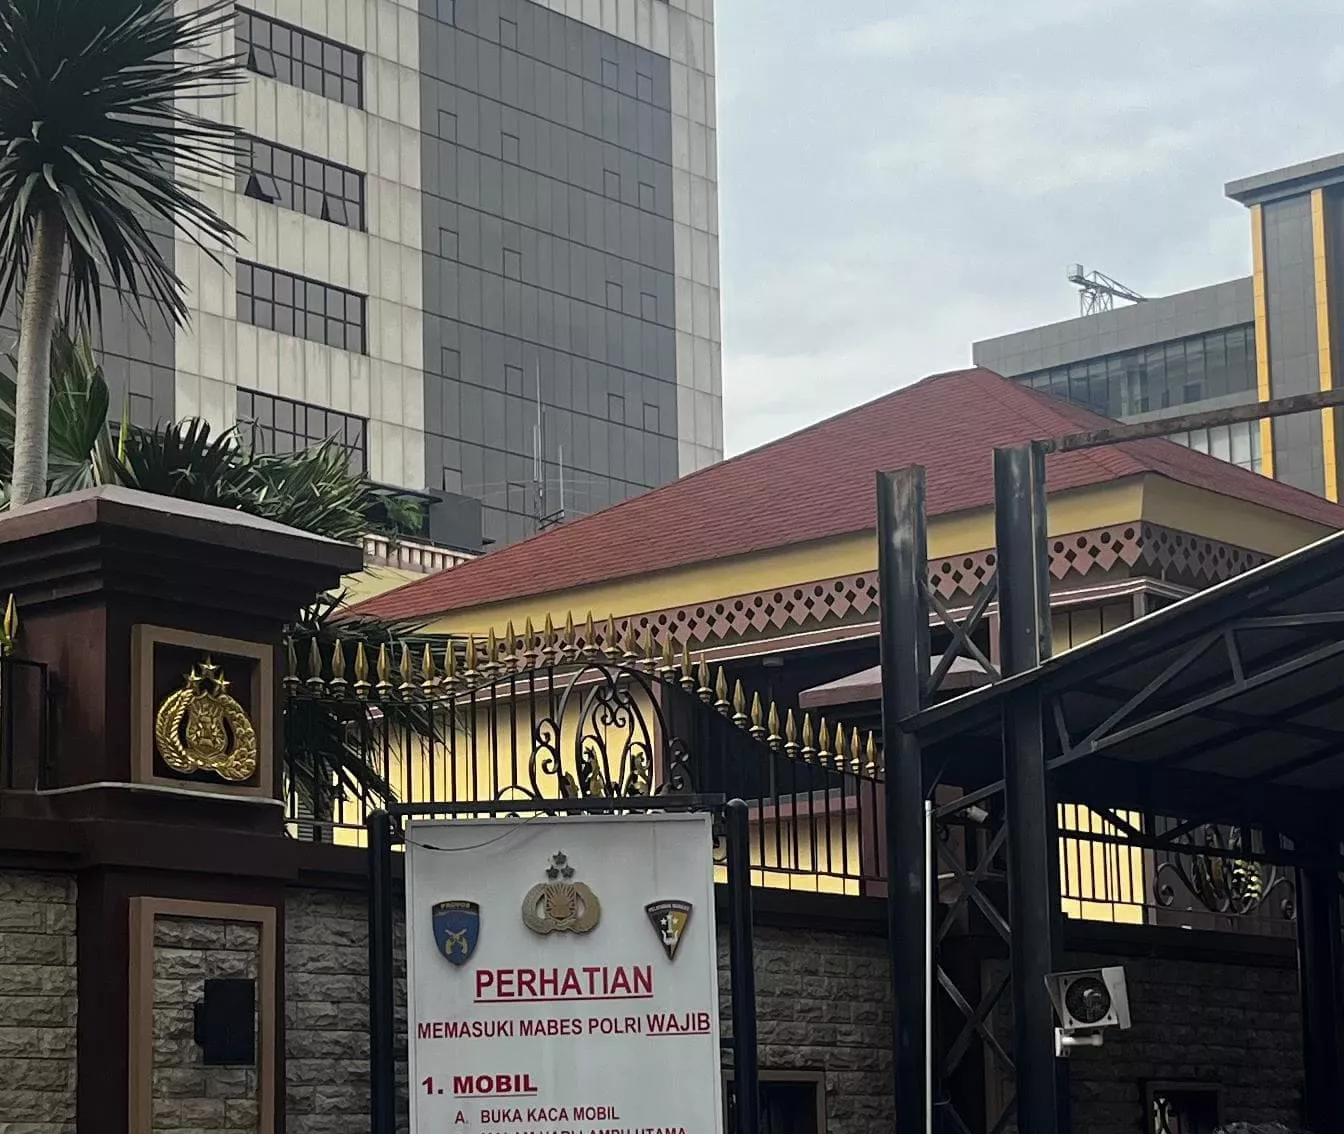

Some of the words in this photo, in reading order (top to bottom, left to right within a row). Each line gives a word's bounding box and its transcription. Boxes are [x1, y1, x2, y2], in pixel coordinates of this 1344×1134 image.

[476, 965, 653, 998] PERHATIAN
[417, 1020, 514, 1039] MEMASUKI
[519, 1018, 583, 1036] MABES
[588, 1017, 641, 1034] POLRI
[646, 1012, 711, 1032] WAJIB
[422, 1076, 444, 1095] 1.
[453, 1074, 538, 1095] MOBIL
[481, 1109, 523, 1124] BUKA
[526, 1107, 568, 1122] KACA
[573, 1106, 621, 1121] MOBIL
